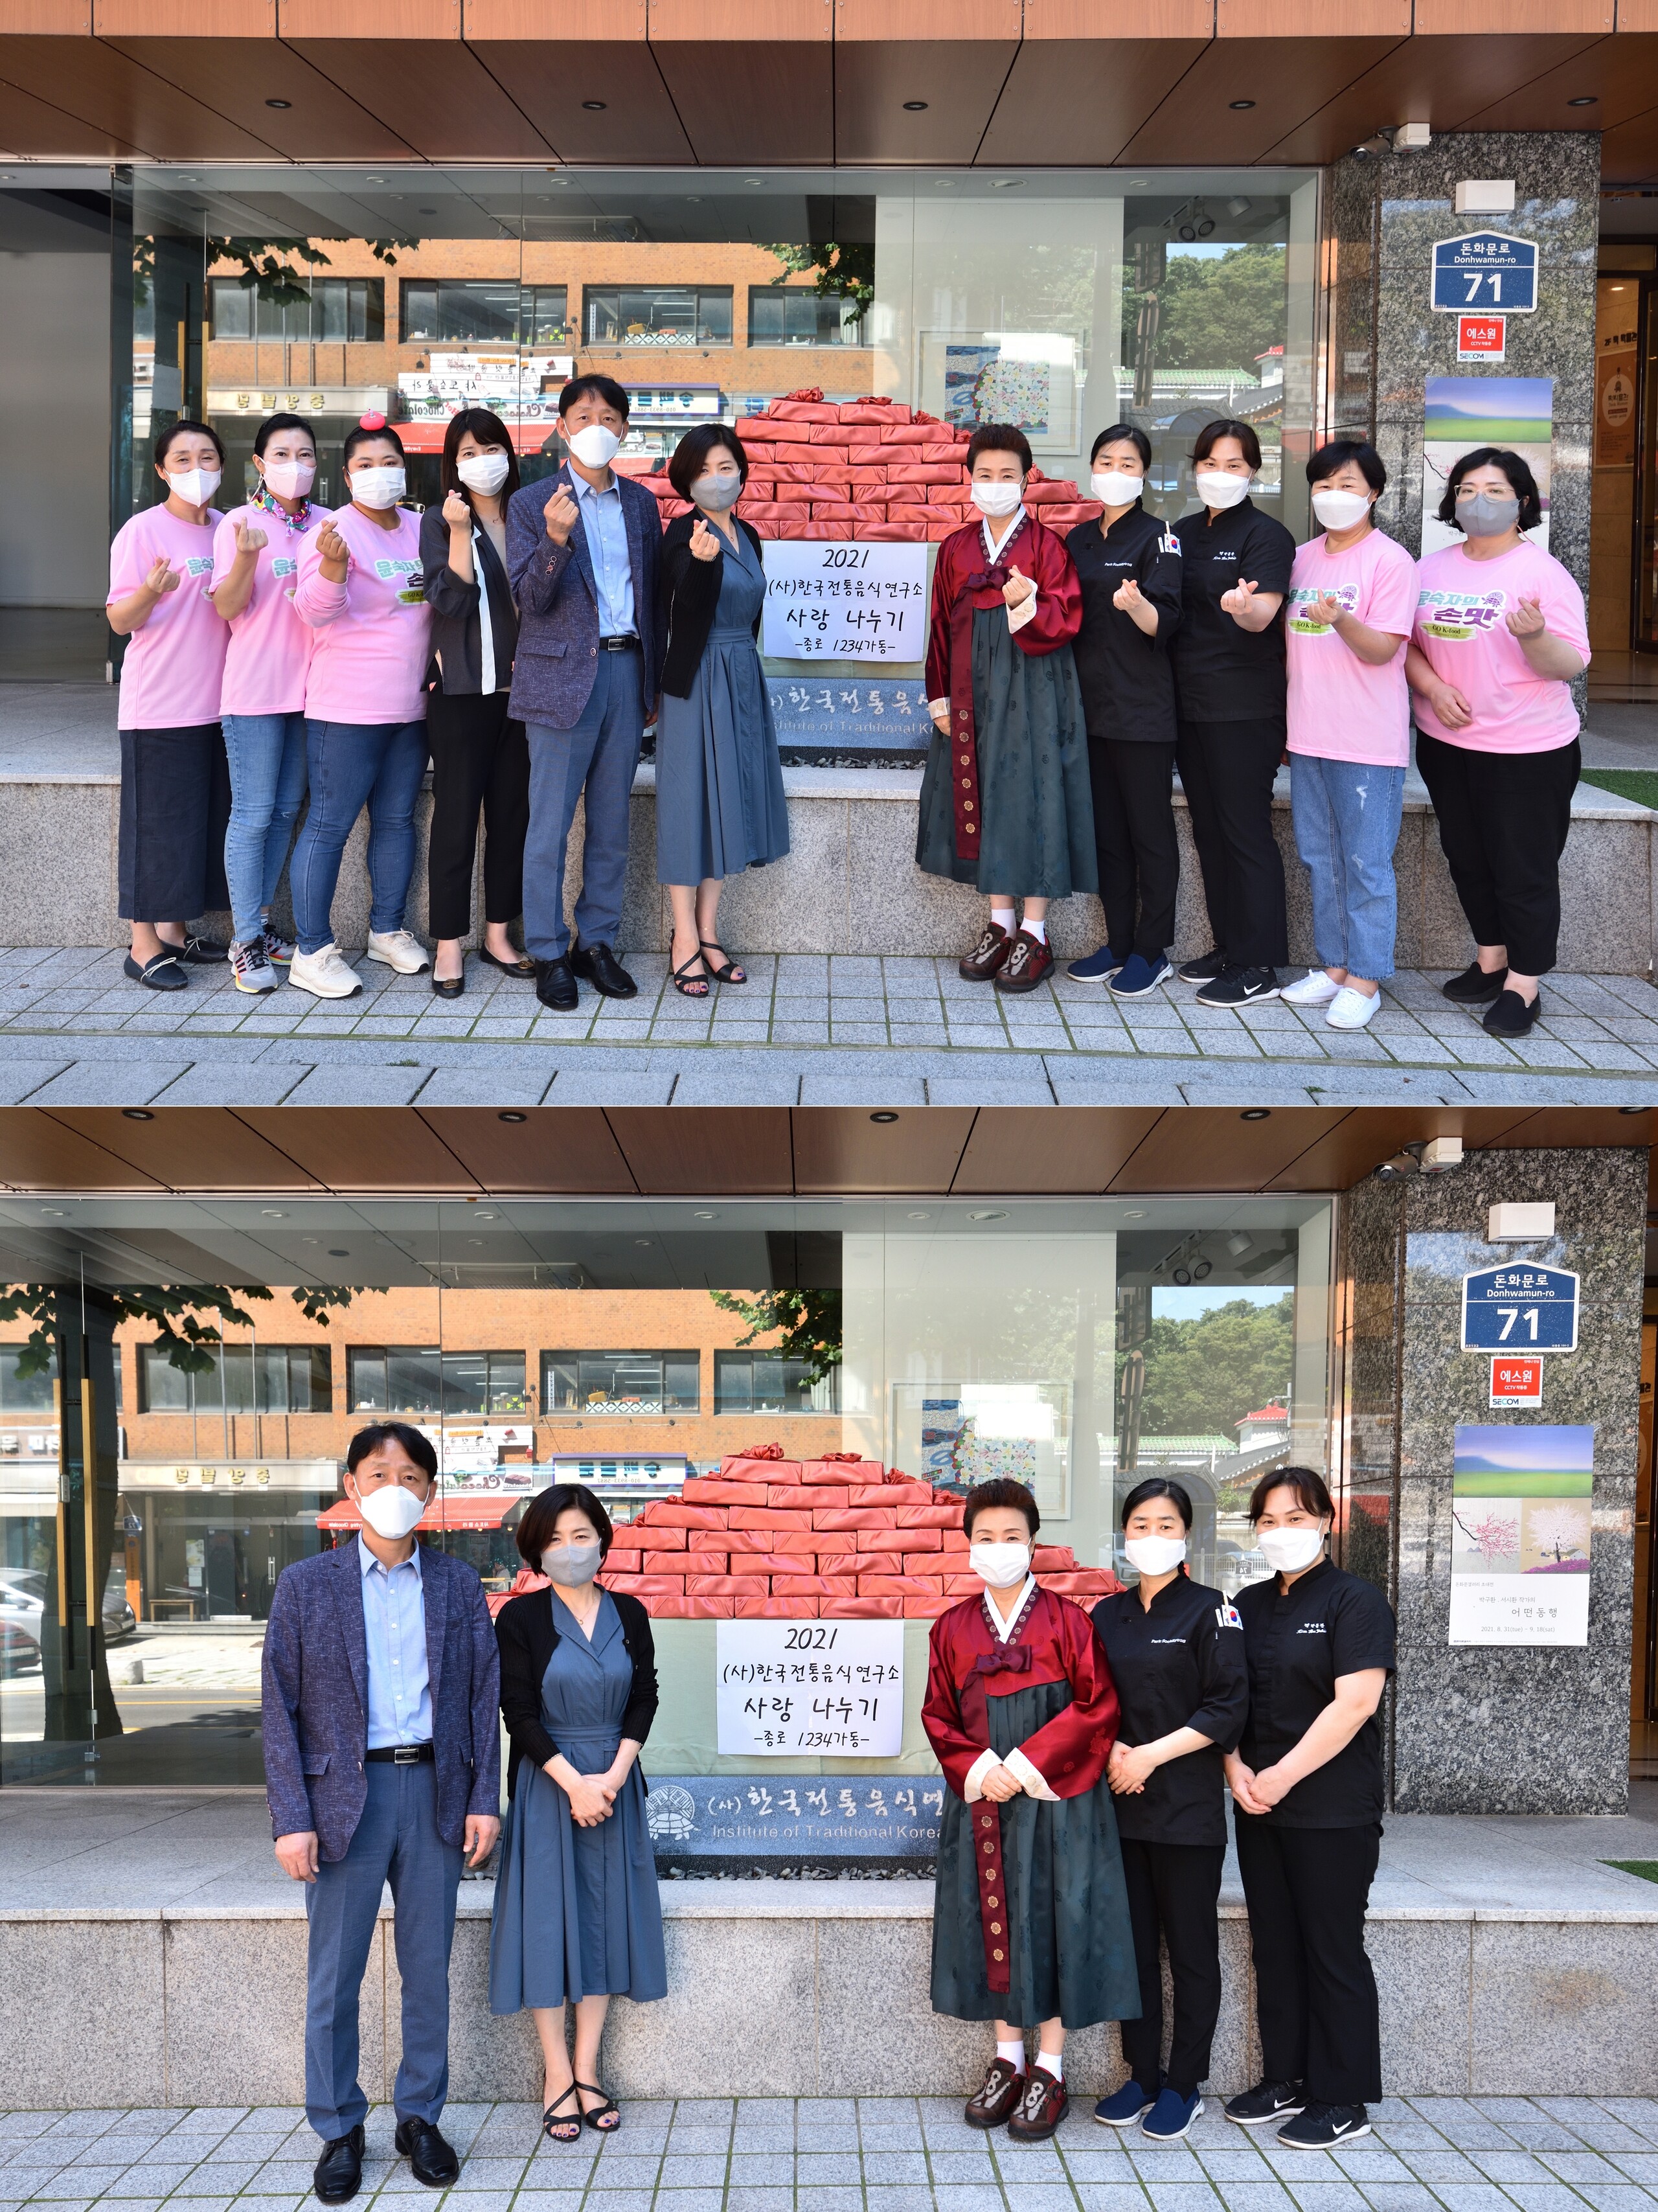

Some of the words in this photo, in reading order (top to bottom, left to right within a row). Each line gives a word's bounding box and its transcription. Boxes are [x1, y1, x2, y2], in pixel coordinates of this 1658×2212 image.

[1460, 243, 1510, 255] 돈화문로
[1464, 273, 1501, 302] 71
[1466, 328, 1496, 339] 에스원
[822, 549, 869, 568] 2021
[769, 579, 923, 599] (사)한국전통음식연구소
[786, 609, 830, 631] 사랑
[846, 610, 904, 633] 나누기
[1434, 608, 1499, 629] 손맛
[820, 721, 833, 733] of
[839, 721, 915, 735] Traditional
[1494, 1274, 1549, 1288] 돈화문로
[1487, 1289, 1554, 1297] Donhwamun-ro
[1497, 1308, 1539, 1341] 71
[1500, 1370, 1532, 1383] 에스원
[784, 1628, 838, 1650] 2021
[723, 1663, 900, 1685] (사)한국전통음식연구소
[744, 1697, 794, 1723] 사랑
[812, 1697, 878, 1724] 나누기
[713, 1825, 778, 1838] Institute
[784, 1825, 798, 1838] of
[806, 1825, 892, 1839] Traditional
